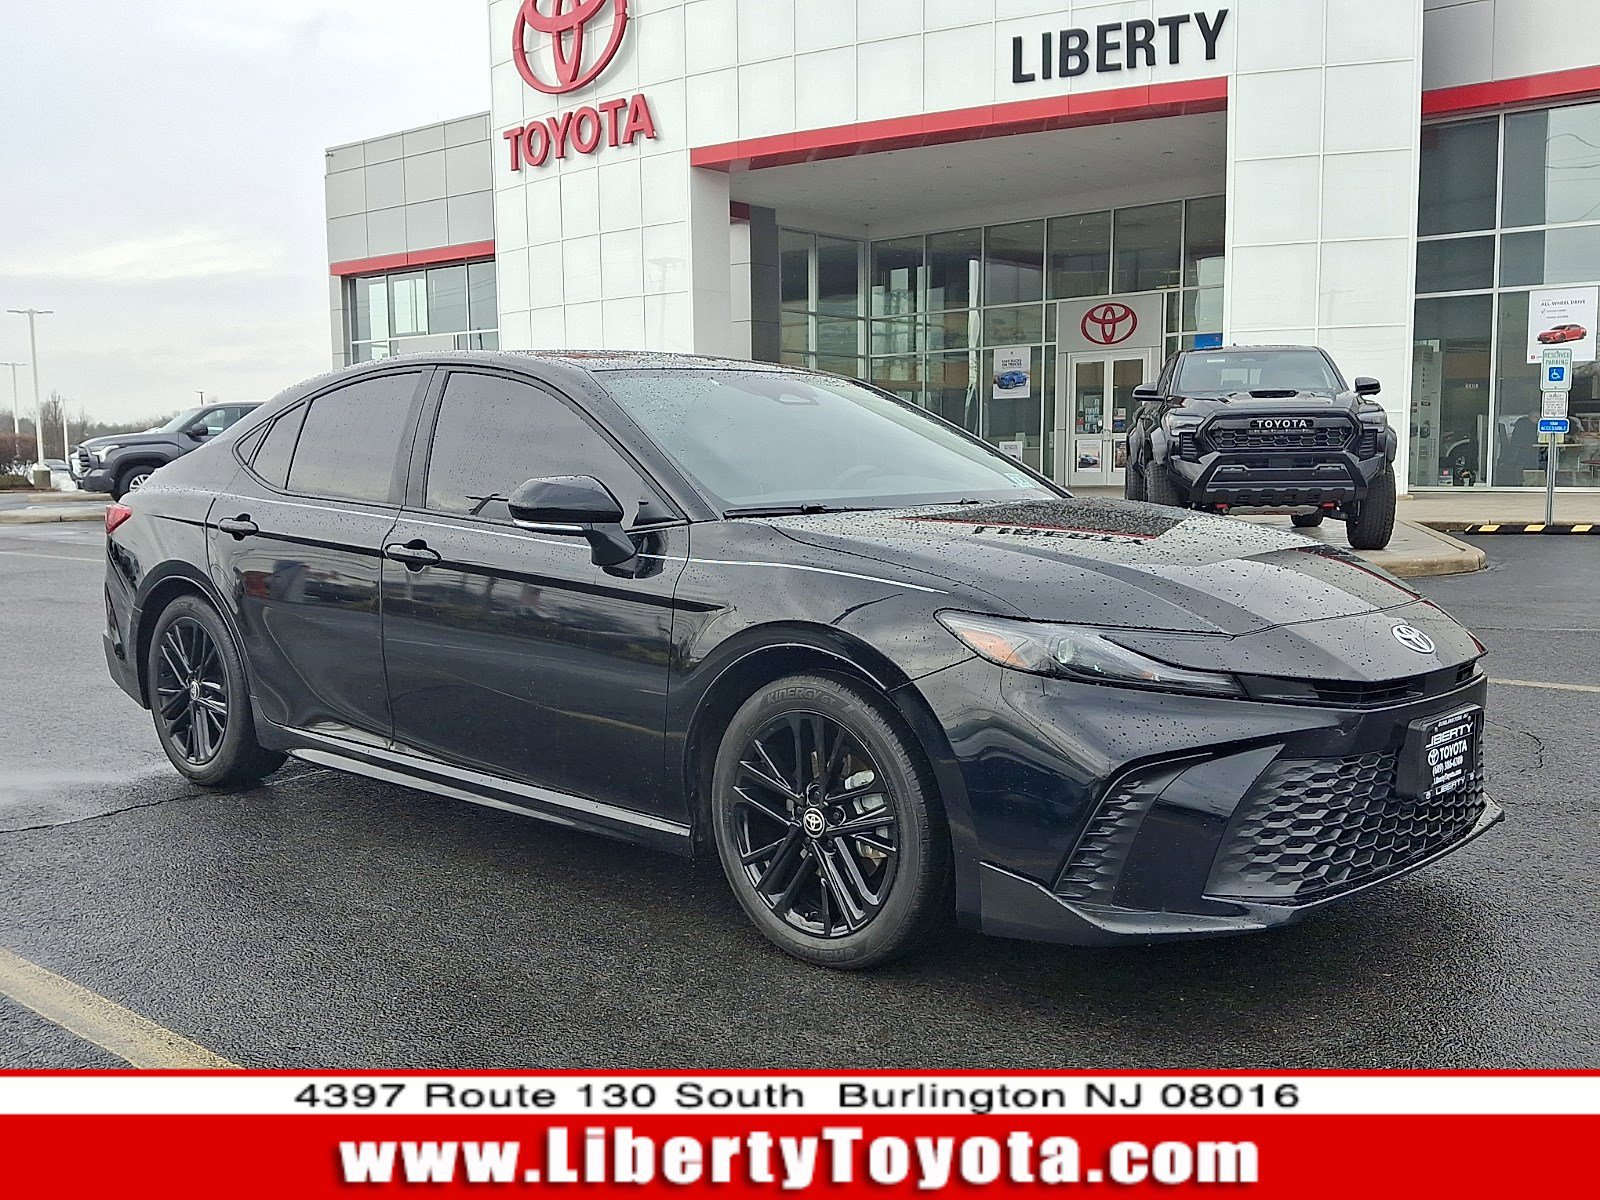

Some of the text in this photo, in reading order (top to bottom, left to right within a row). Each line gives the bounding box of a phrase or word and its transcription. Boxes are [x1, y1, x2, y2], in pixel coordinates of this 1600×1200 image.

[1012, 9, 1229, 83] LIBERTY
[503, 93, 657, 171] TOYOTA
[1257, 419, 1307, 428] TOYOTA
[767, 686, 821, 705] KINERGY
[1425, 721, 1474, 749] LIBERTY
[1440, 739, 1468, 761] TOYOTA
[1435, 775, 1467, 796] LIBERTY
